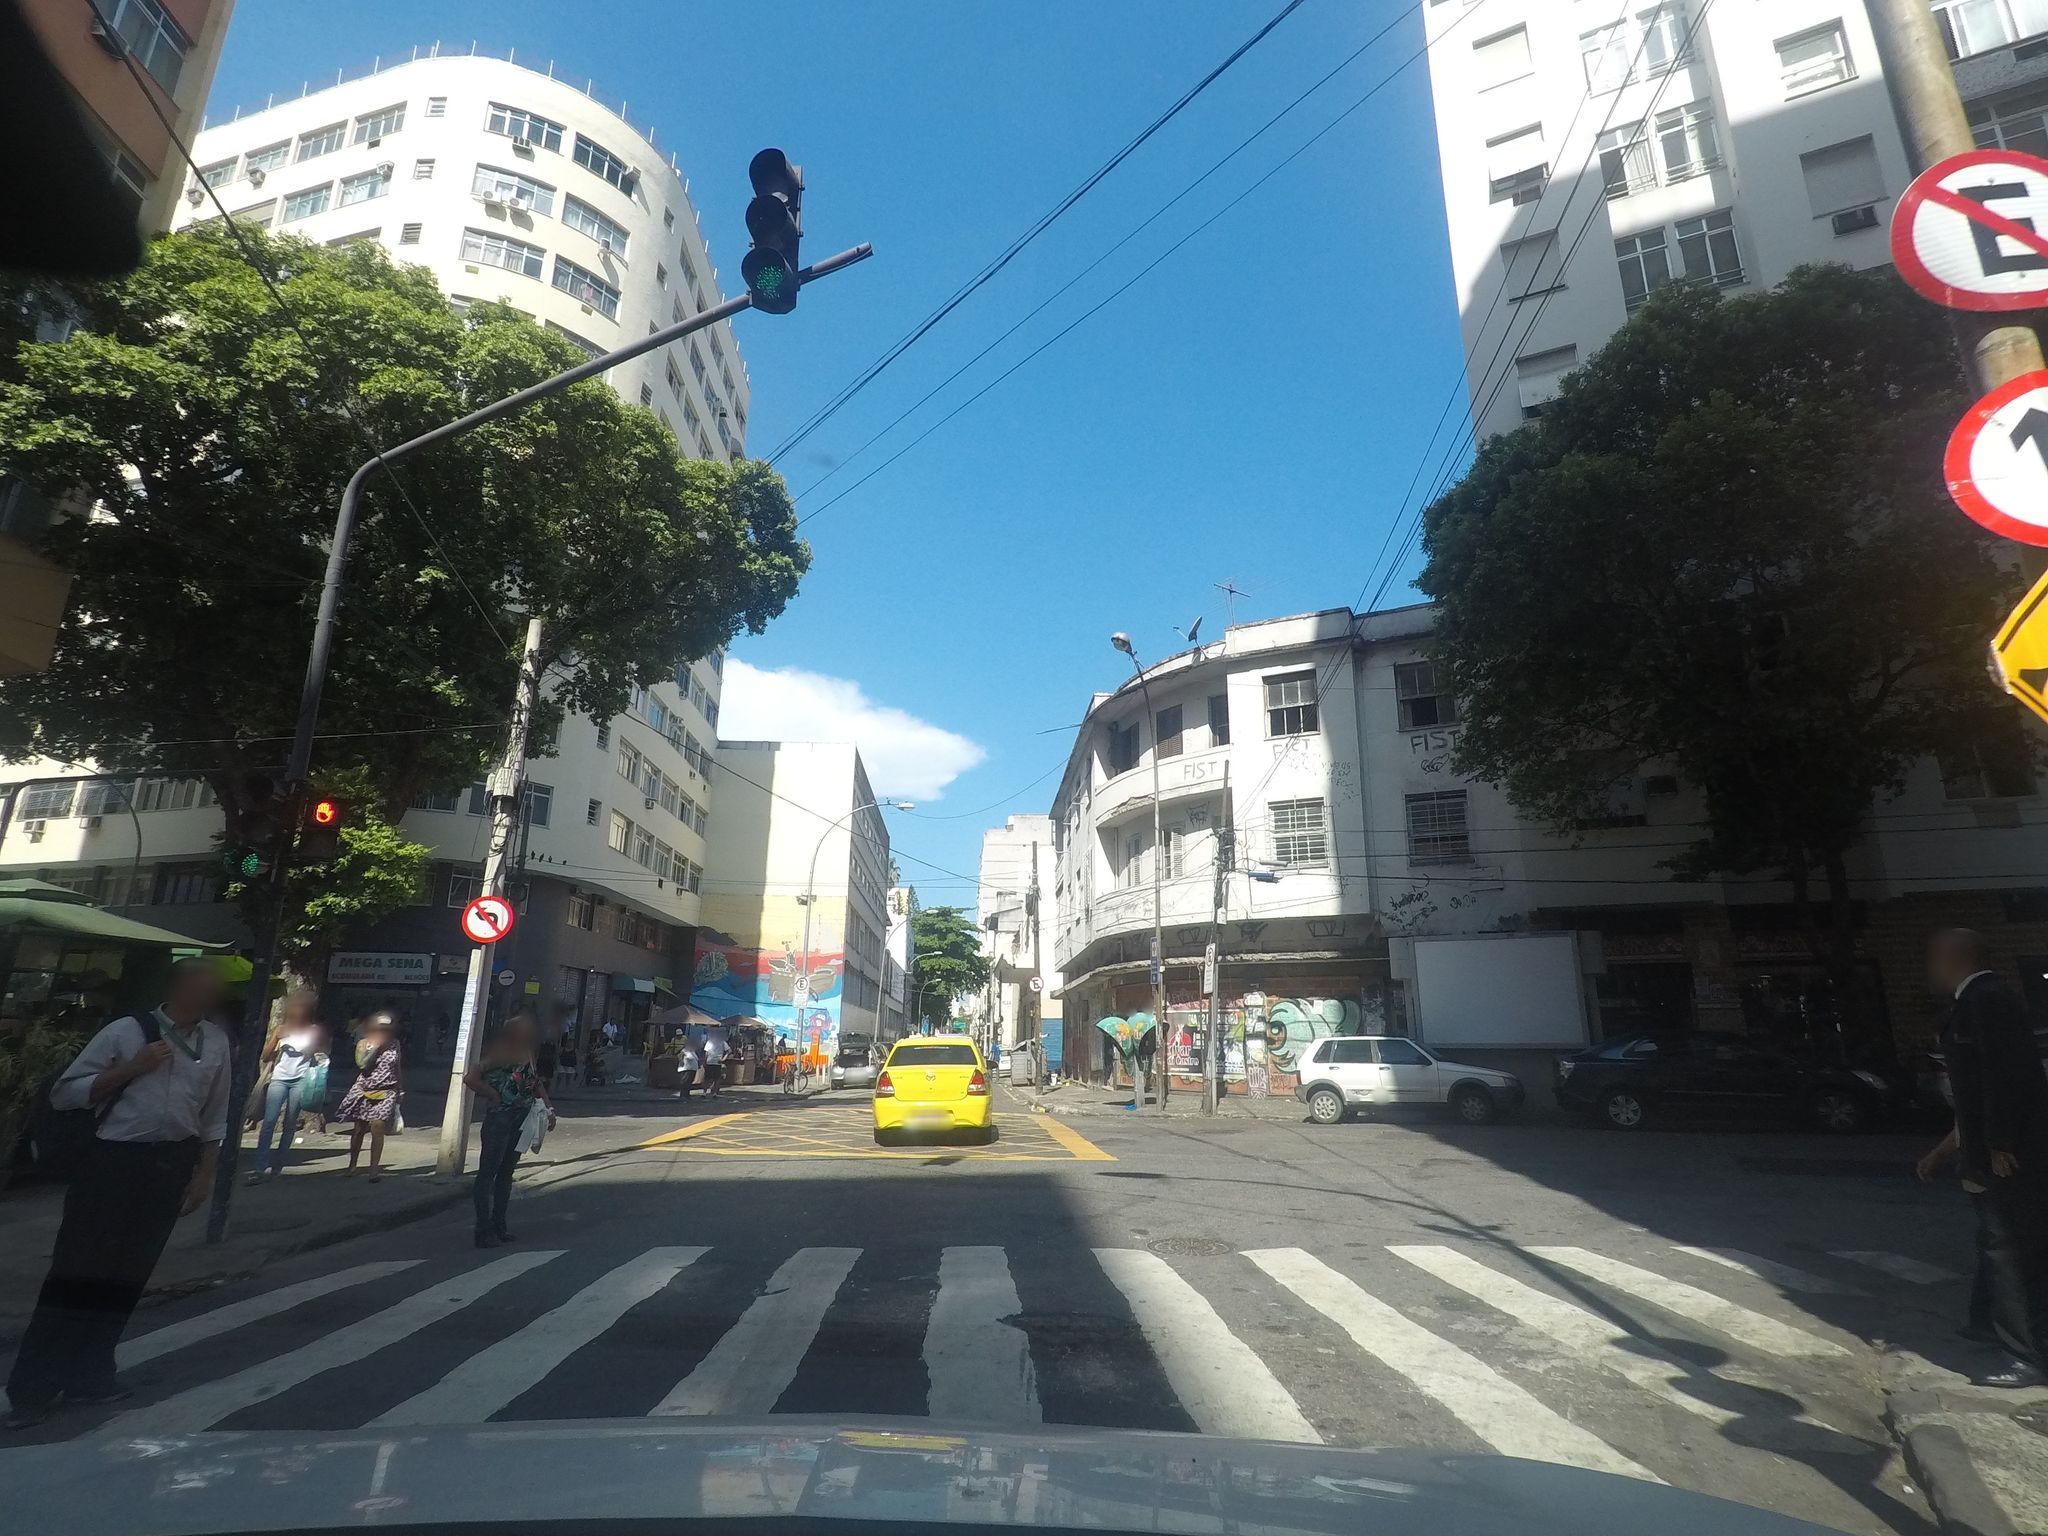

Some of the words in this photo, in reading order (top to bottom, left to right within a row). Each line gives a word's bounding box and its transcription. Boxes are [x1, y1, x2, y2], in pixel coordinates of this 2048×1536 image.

[1957, 181, 2048, 277] E
[1411, 730, 1461, 754] FIST
[1184, 761, 1217, 780] FIST
[338, 957, 385, 969] MEGA
[387, 958, 424, 969] SENA
